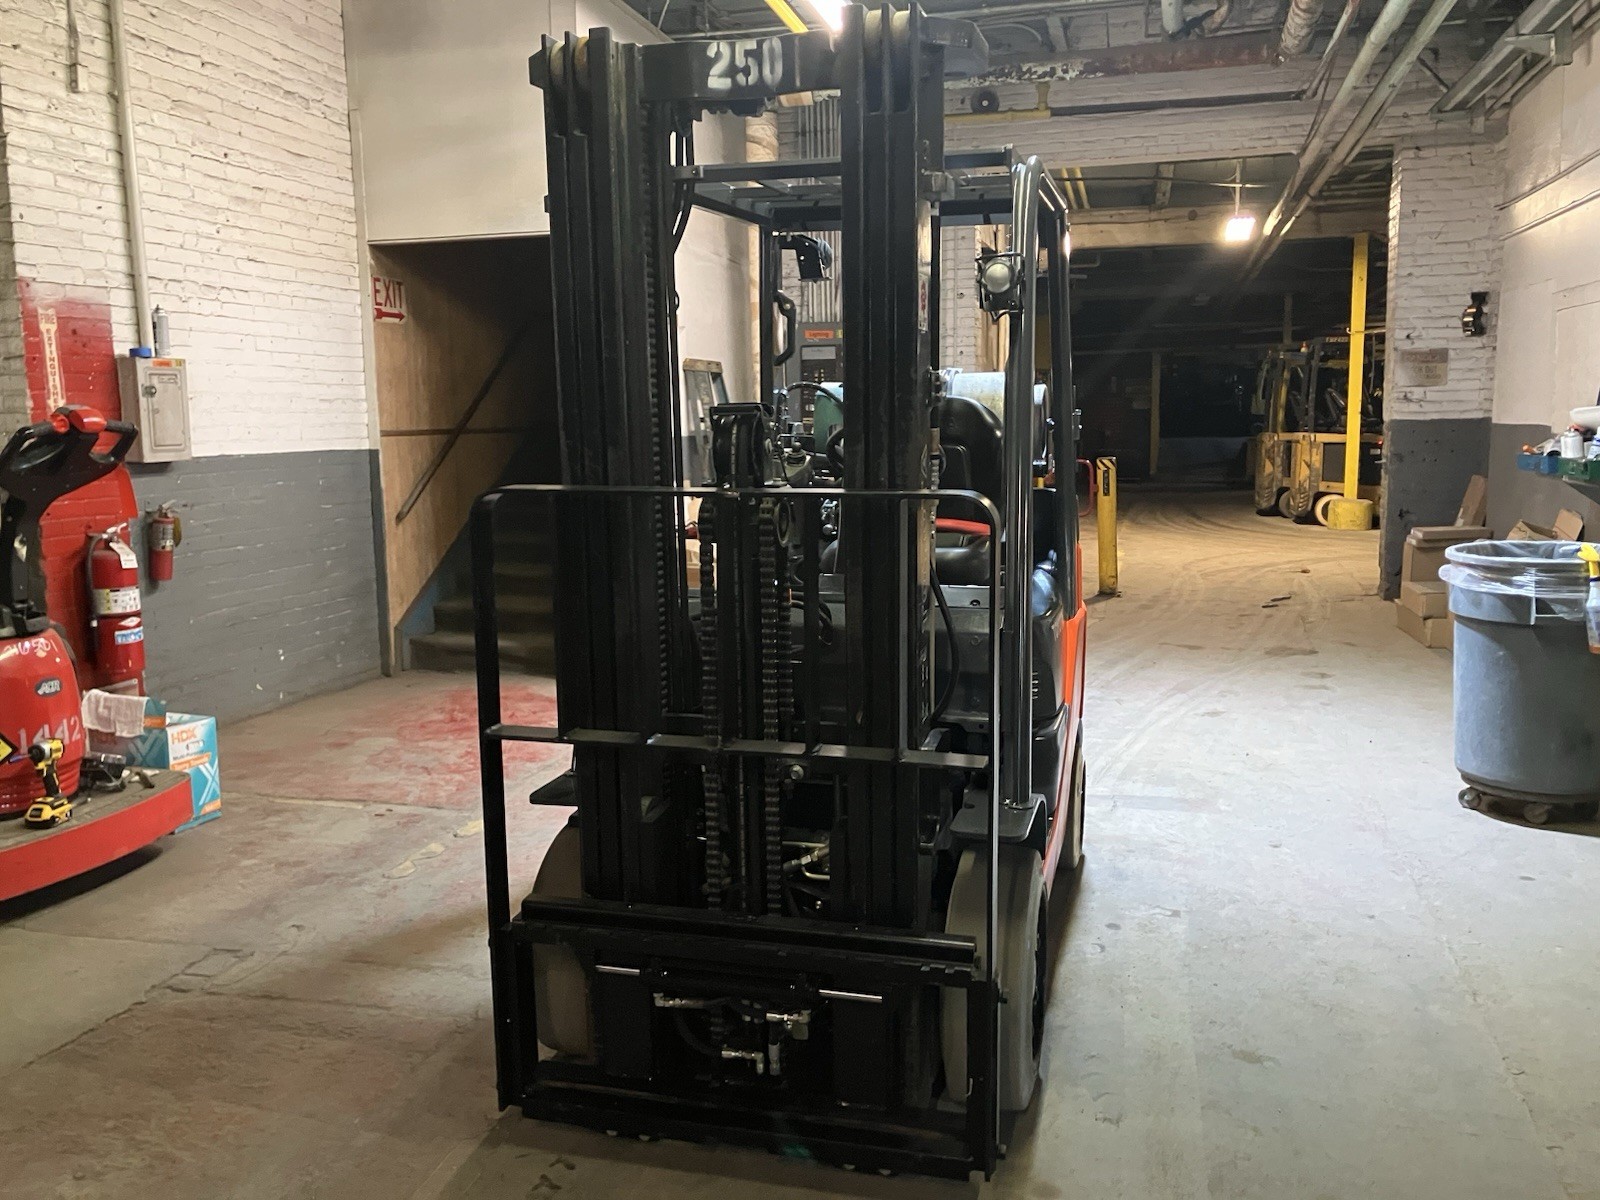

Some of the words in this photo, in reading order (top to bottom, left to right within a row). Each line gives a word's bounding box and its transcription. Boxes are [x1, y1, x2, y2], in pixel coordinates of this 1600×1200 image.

[706, 37, 783, 89] 250
[373, 276, 404, 309] EXIT
[40, 313, 56, 325] FIRE
[171, 726, 198, 745] HDX
